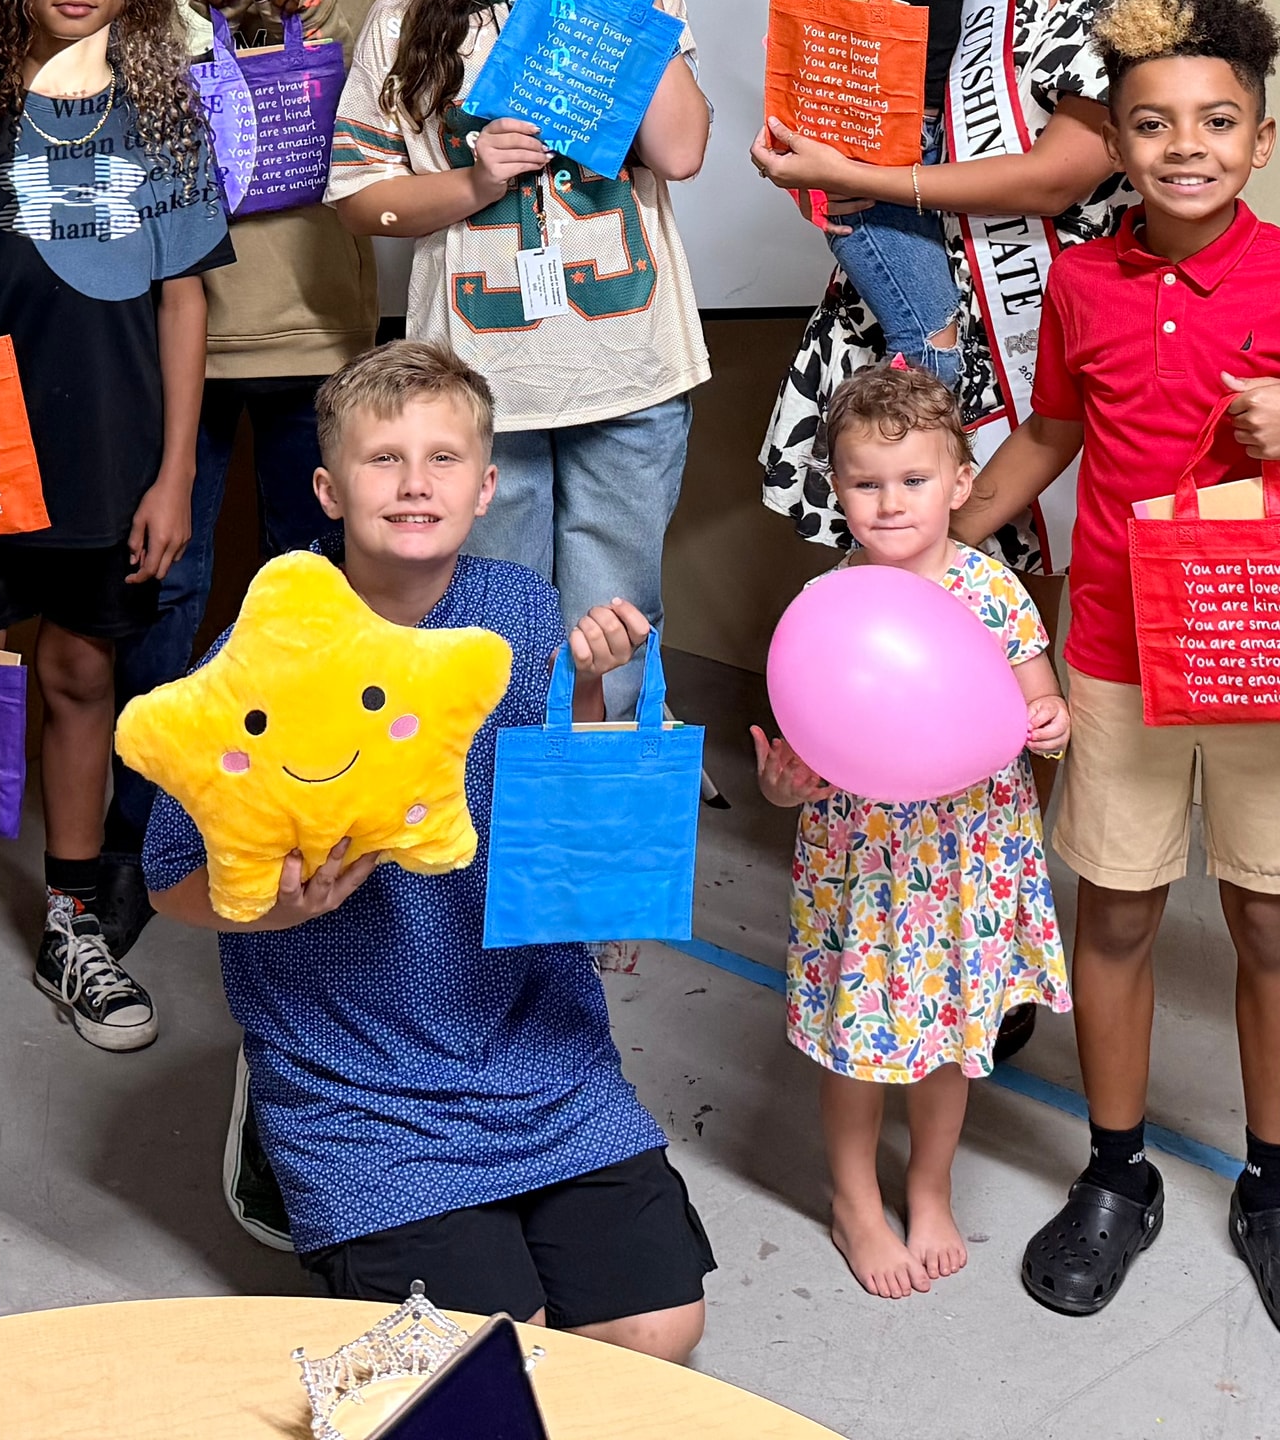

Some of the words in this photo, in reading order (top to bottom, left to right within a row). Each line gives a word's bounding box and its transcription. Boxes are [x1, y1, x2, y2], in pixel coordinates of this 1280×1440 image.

[552, 16, 570, 34] You
[573, 31, 593, 45] are
[596, 37, 627, 60] loved
[803, 24, 825, 38] You
[828, 31, 847, 43] are
[850, 32, 881, 49] brave
[803, 55, 825, 67] You
[828, 61, 848, 73] are
[851, 63, 877, 79] kind
[799, 68, 820, 82] You
[823, 75, 842, 87] are
[846, 79, 880, 94] smart
[235, 116, 258, 128] You
[261, 112, 280, 124] are
[284, 107, 311, 121] kind
[508, 97, 528, 114] You
[531, 110, 551, 125] are
[553, 121, 590, 144] unique
[794, 110, 814, 123] You
[817, 117, 836, 127] are
[841, 120, 884, 139] enough
[233, 131, 256, 143] You
[259, 126, 279, 137] are
[282, 120, 316, 135] smart
[236, 159, 259, 170] You
[263, 154, 282, 166] are
[286, 149, 322, 162] strong
[1184, 581, 1214, 594] You
[1218, 583, 1245, 594] are
[1183, 618, 1214, 631] You
[1218, 619, 1244, 630] are
[1185, 654, 1215, 667] You
[1219, 657, 1245, 667] are
[1183, 672, 1213, 685] You
[1217, 675, 1243, 685] are
